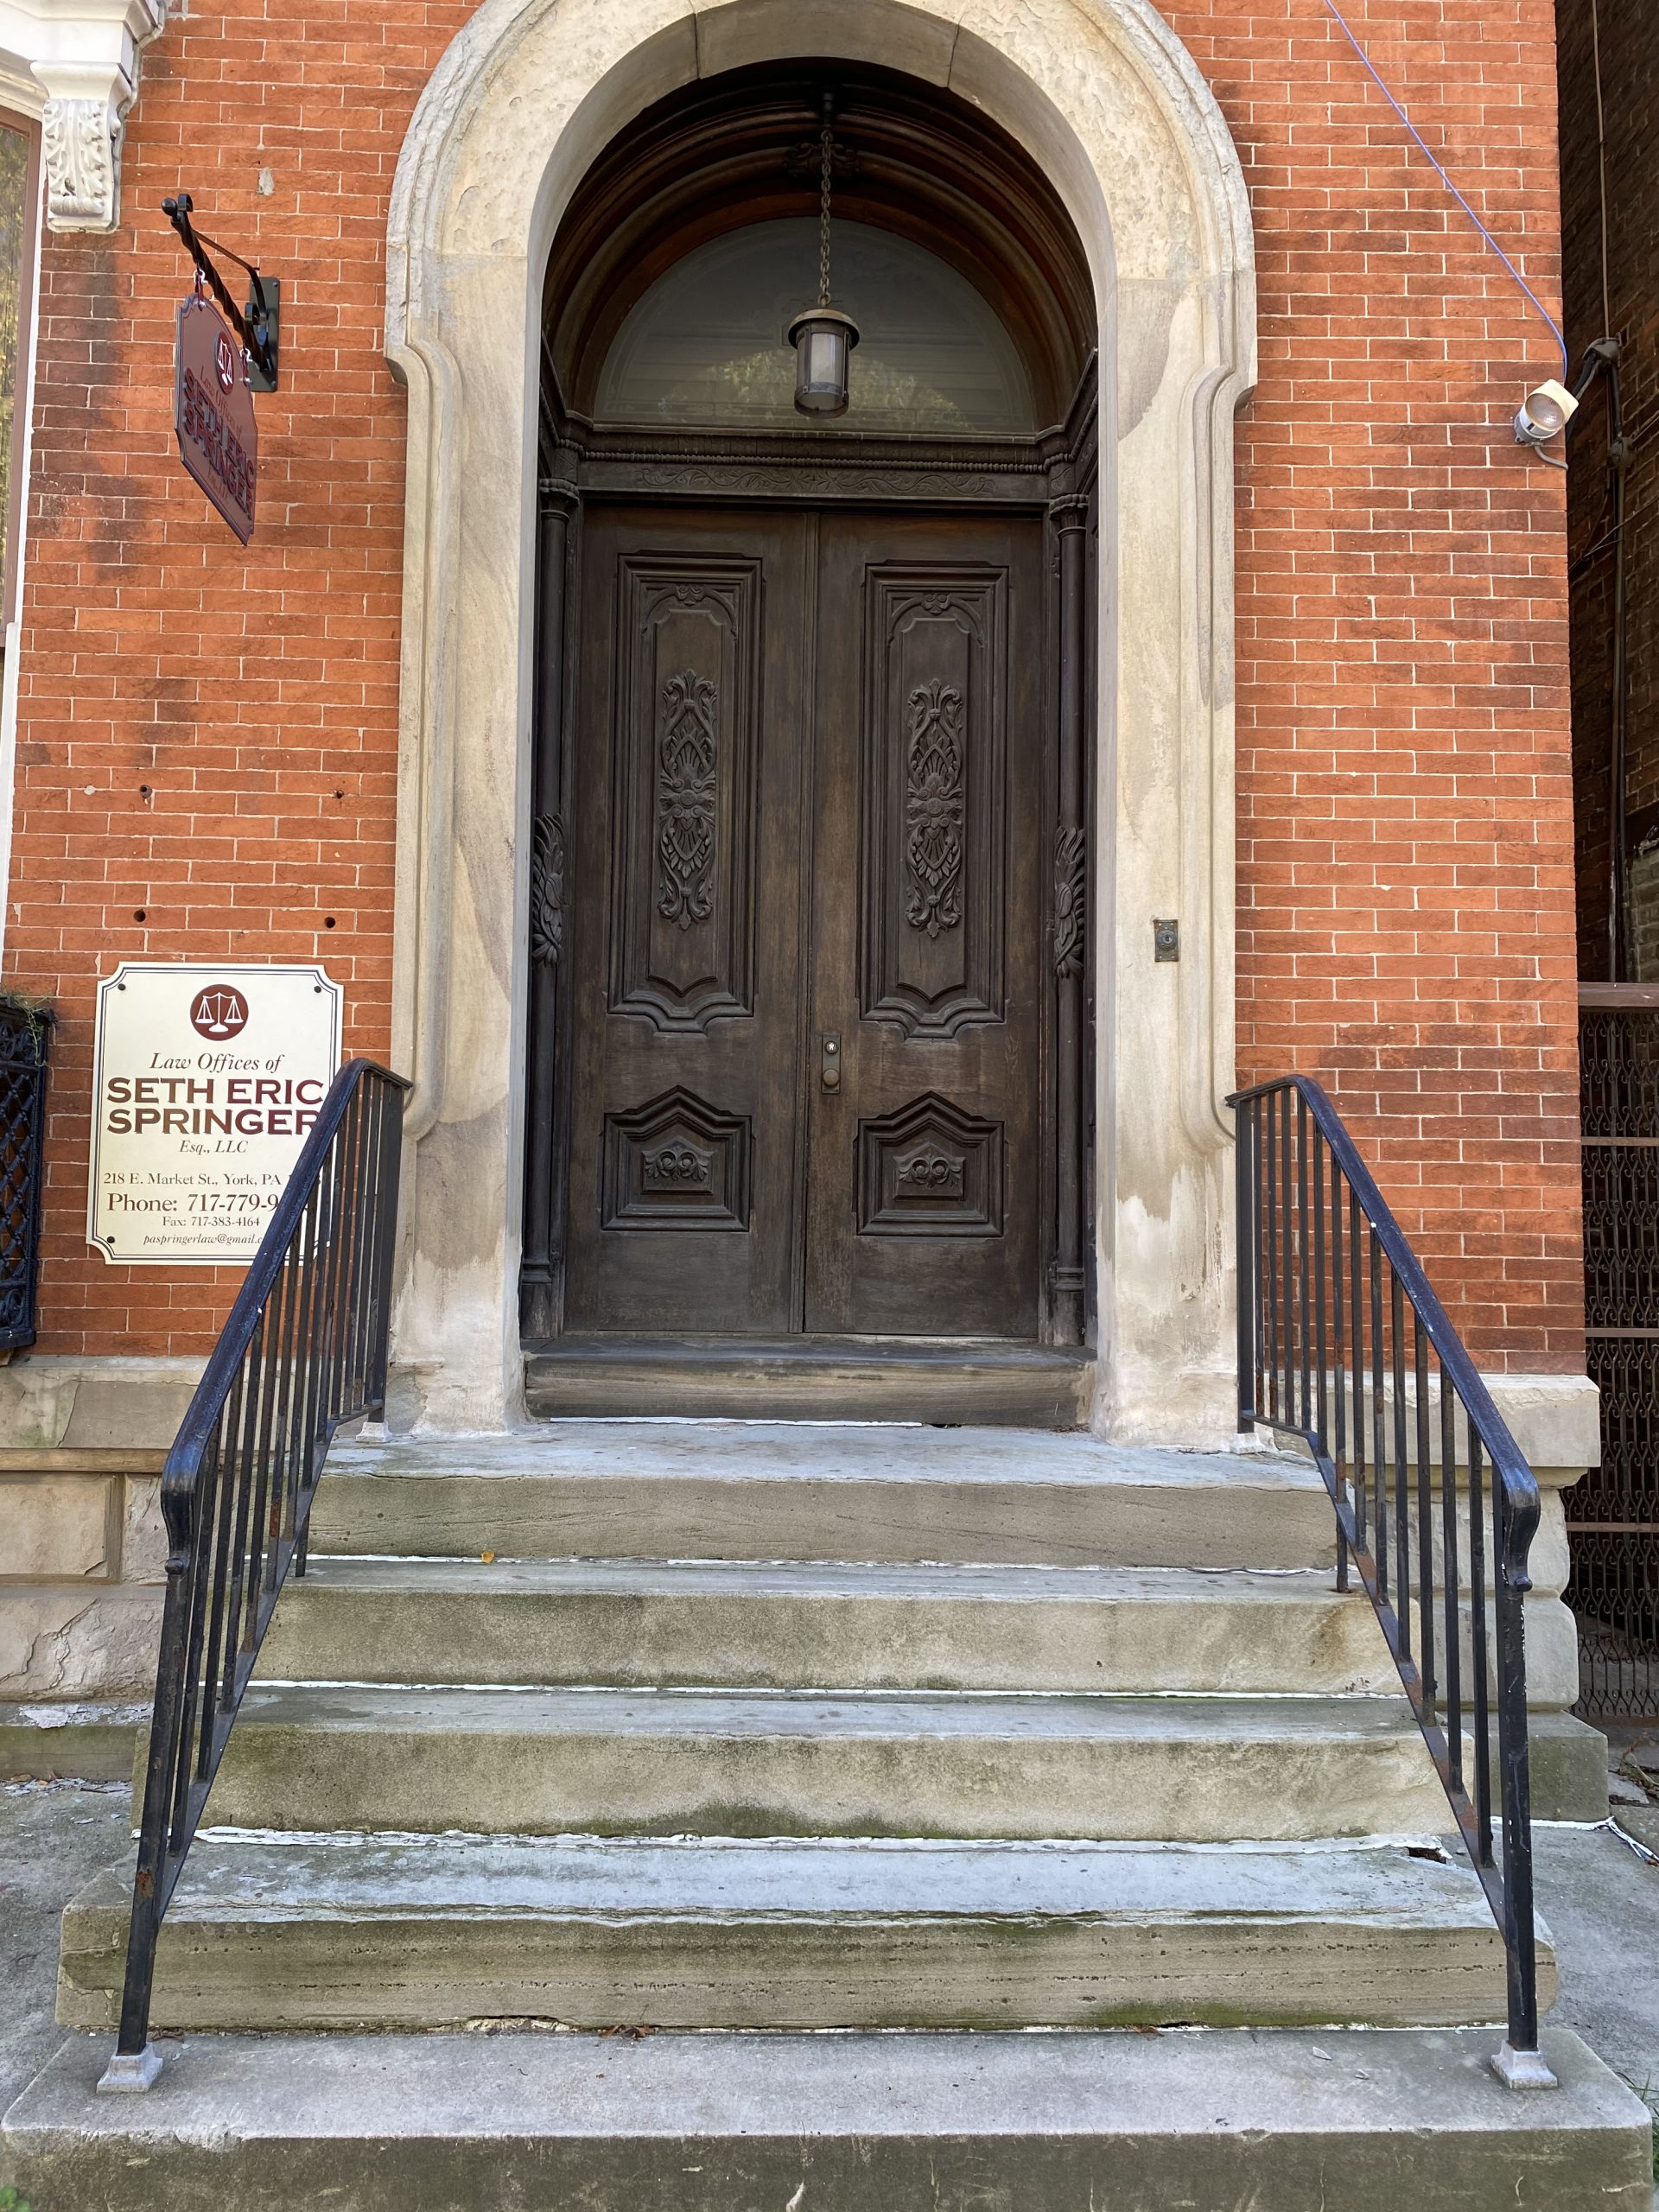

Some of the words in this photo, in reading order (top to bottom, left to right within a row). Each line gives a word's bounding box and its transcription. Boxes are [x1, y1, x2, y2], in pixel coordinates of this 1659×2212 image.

[184, 366, 224, 446] SETH
[225, 425, 255, 489] ERIC
[184, 401, 253, 520] SPRINGER
[149, 1052, 191, 1069] Law
[197, 1052, 259, 1073] Offices
[265, 1054, 285, 1074] of
[106, 1077, 214, 1104] SETH
[226, 1078, 324, 1105] ERIC
[106, 1108, 321, 1135] SPRINGER
[179, 1140, 210, 1154] Esq.,
[215, 1140, 249, 1154] LLC
[103, 1173, 125, 1185] 218
[130, 1173, 143, 1185] E.
[148, 1173, 194, 1185] Market
[198, 1173, 219, 1186] St.,
[224, 1173, 257, 1187] York,
[262, 1173, 282, 1185] PA
[106, 1192, 177, 1211] Phone:
[162, 1216, 187, 1227] Fax:
[191, 1217, 260, 1227] 717-383-4164
